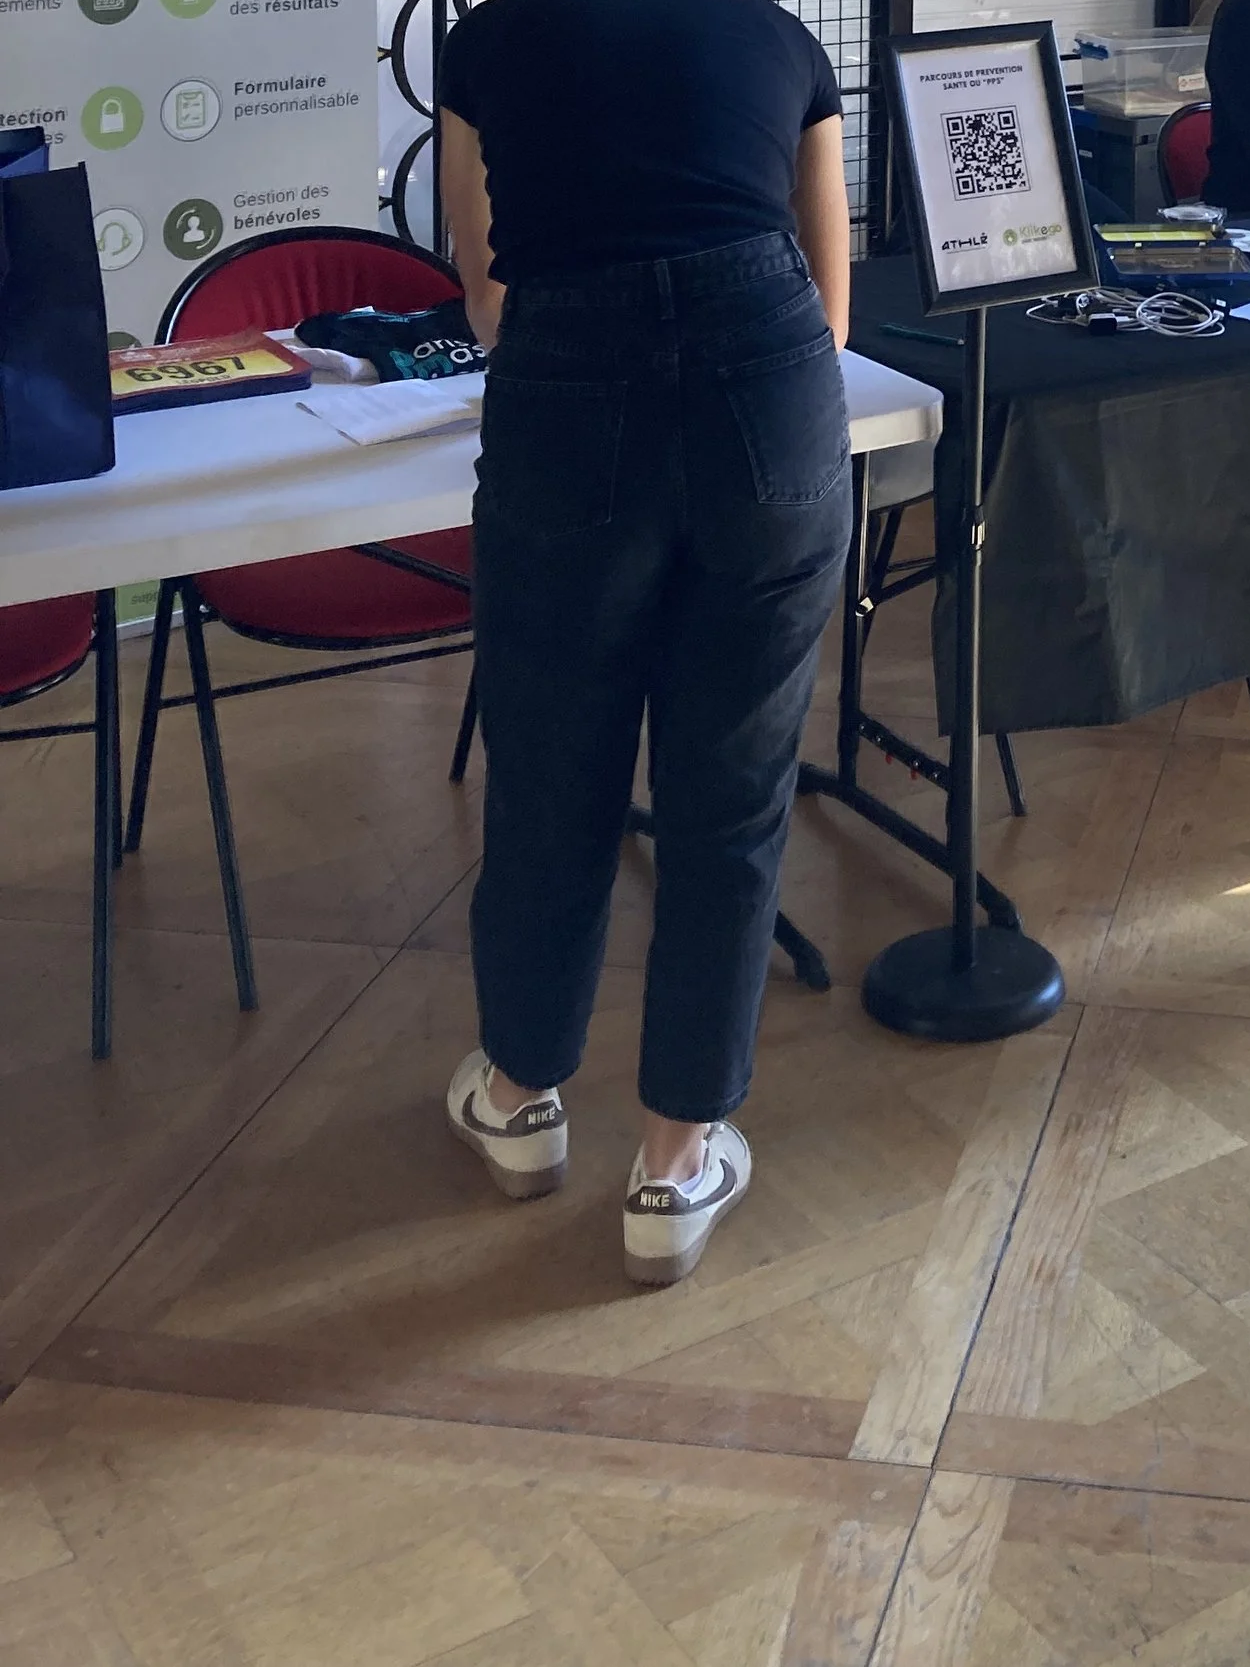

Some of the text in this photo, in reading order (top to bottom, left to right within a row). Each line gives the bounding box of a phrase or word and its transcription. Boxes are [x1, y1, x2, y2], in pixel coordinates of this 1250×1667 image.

[229, 0, 259, 16] des
[920, 65, 1023, 83] PARCOURS DE PREVENTION
[233, 75, 327, 96] Formulaire
[943, 81, 967, 91] SANTE
[969, 80, 981, 88] OU
[233, 91, 360, 120] personnalisable
[233, 184, 329, 209] Gestion des
[233, 205, 321, 230] bénévoles
[126, 356, 246, 383] 6967
[528, 1107, 557, 1125] NIKE
[640, 1192, 670, 1208] NIKE
